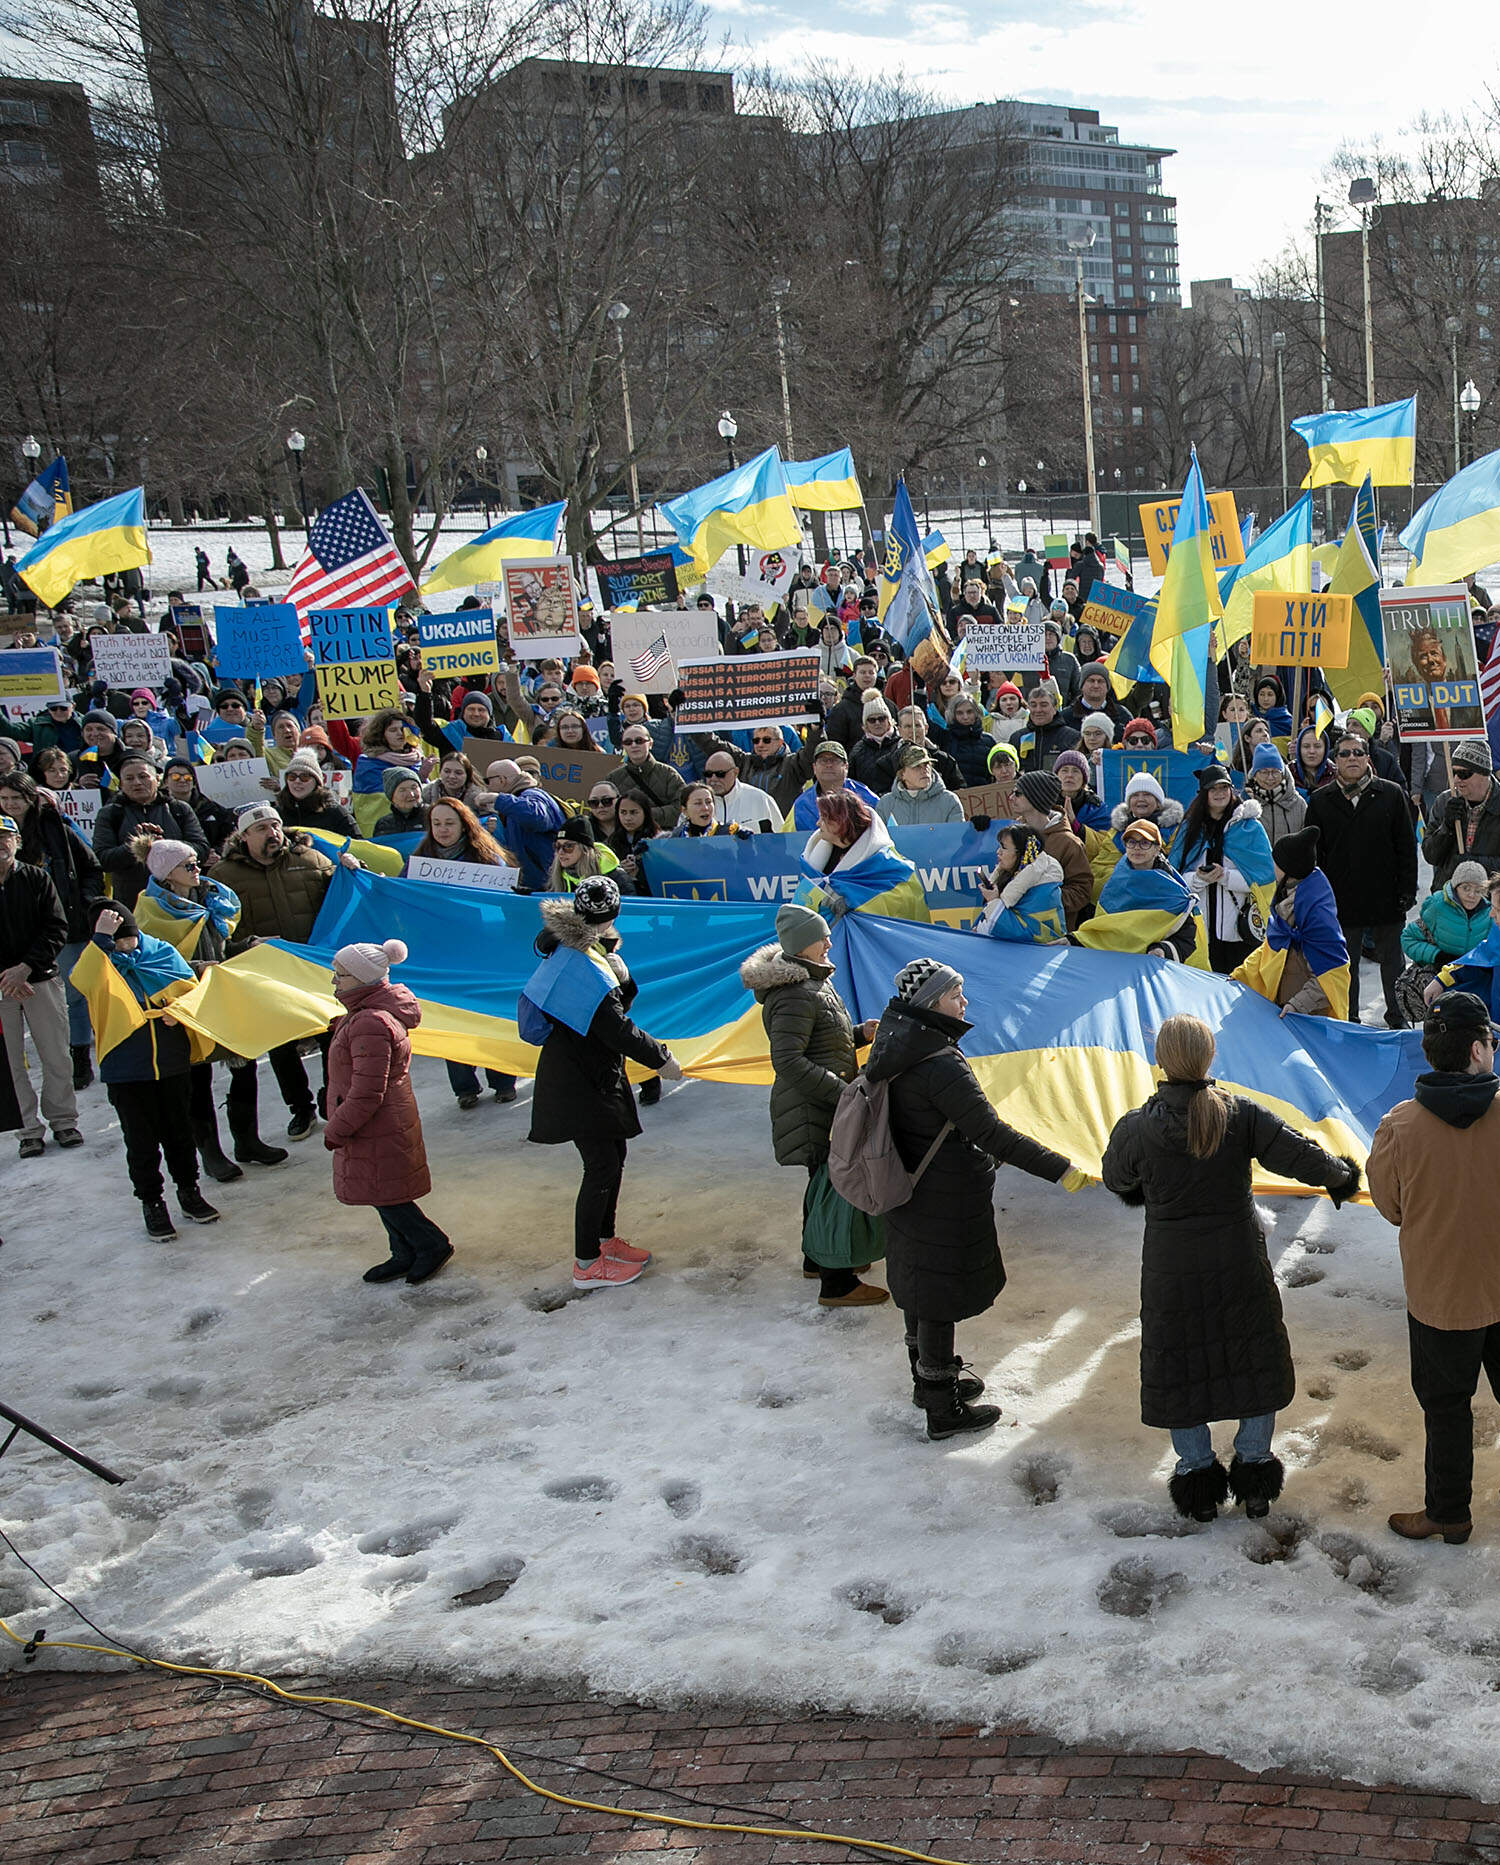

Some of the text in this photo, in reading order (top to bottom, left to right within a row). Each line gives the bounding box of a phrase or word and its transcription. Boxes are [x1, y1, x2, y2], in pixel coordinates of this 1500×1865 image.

[607, 571, 666, 590] SUPPORT
[611, 587, 669, 607] UKRAINE
[1094, 586, 1144, 613] STOP
[253, 611, 281, 623] ALL
[310, 611, 384, 637] PUTIN
[1085, 605, 1131, 632] GENOCI
[1385, 606, 1463, 631] TRUTH
[232, 625, 287, 643] MUST
[421, 618, 493, 641] UKRAINE
[967, 625, 1045, 635] PEACE ONLY LASTS
[967, 634, 1041, 644] WHEN PEOPLE DO
[92, 636, 119, 648] Truth
[1008, 643, 1033, 652] RIGHT
[1280, 631, 1321, 658] ПТН
[150, 647, 168, 658] NOT
[230, 643, 302, 662] SUPPORT
[425, 650, 494, 671] STRONG
[967, 652, 1044, 665] SUPPORT UKRAINE
[97, 661, 120, 671] start
[230, 656, 298, 673] UKRAINE
[679, 657, 819, 676] RUSSIA IS A TERRORIST STATE
[109, 671, 127, 682] NOT
[316, 663, 395, 688] TRUMP
[679, 669, 818, 688] RUSSIA IS A TERRORIST STATE
[684, 680, 817, 699] USSIA IS A TERRORIST STATE
[1397, 684, 1474, 706] FU DJT
[679, 692, 818, 712] RUSSIA IS A TERRORIST STATE
[678, 704, 806, 723] RUSSIA IS A TERRORIST STA
[213, 760, 254, 779] PEACE
[540, 763, 583, 783] ACE
[419, 861, 466, 881] Don't
[471, 871, 517, 887] trust
[747, 864, 996, 900] WE WITH
